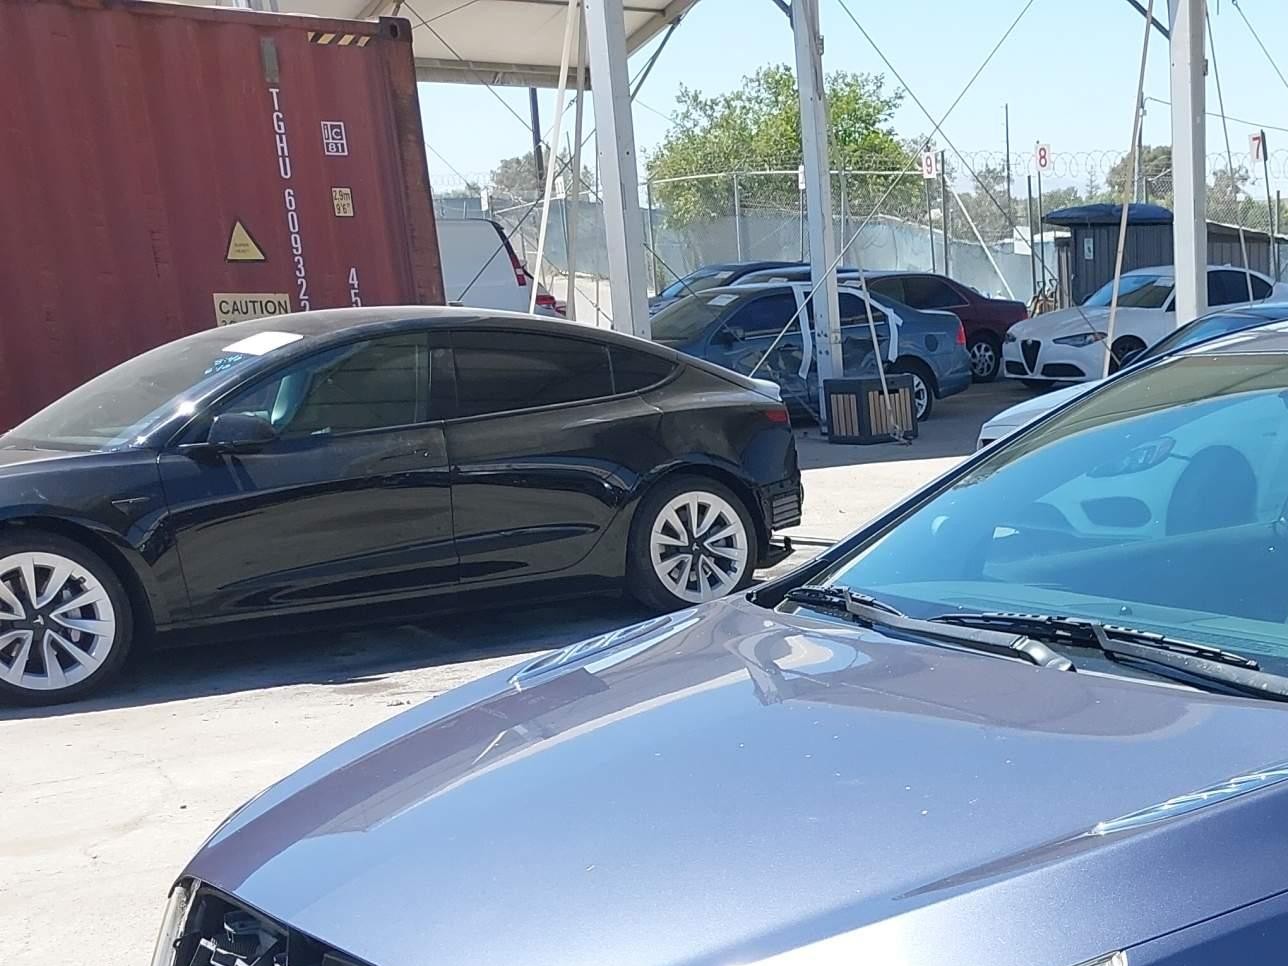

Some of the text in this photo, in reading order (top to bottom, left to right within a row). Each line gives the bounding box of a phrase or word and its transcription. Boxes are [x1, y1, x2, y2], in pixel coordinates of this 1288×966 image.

[268, 87, 292, 179] TGHU
[328, 142, 343, 153] 81
[1251, 136, 1261, 160] 7
[925, 156, 933, 174] 9
[1038, 147, 1048, 168] 8
[218, 300, 289, 315] CAUTION
